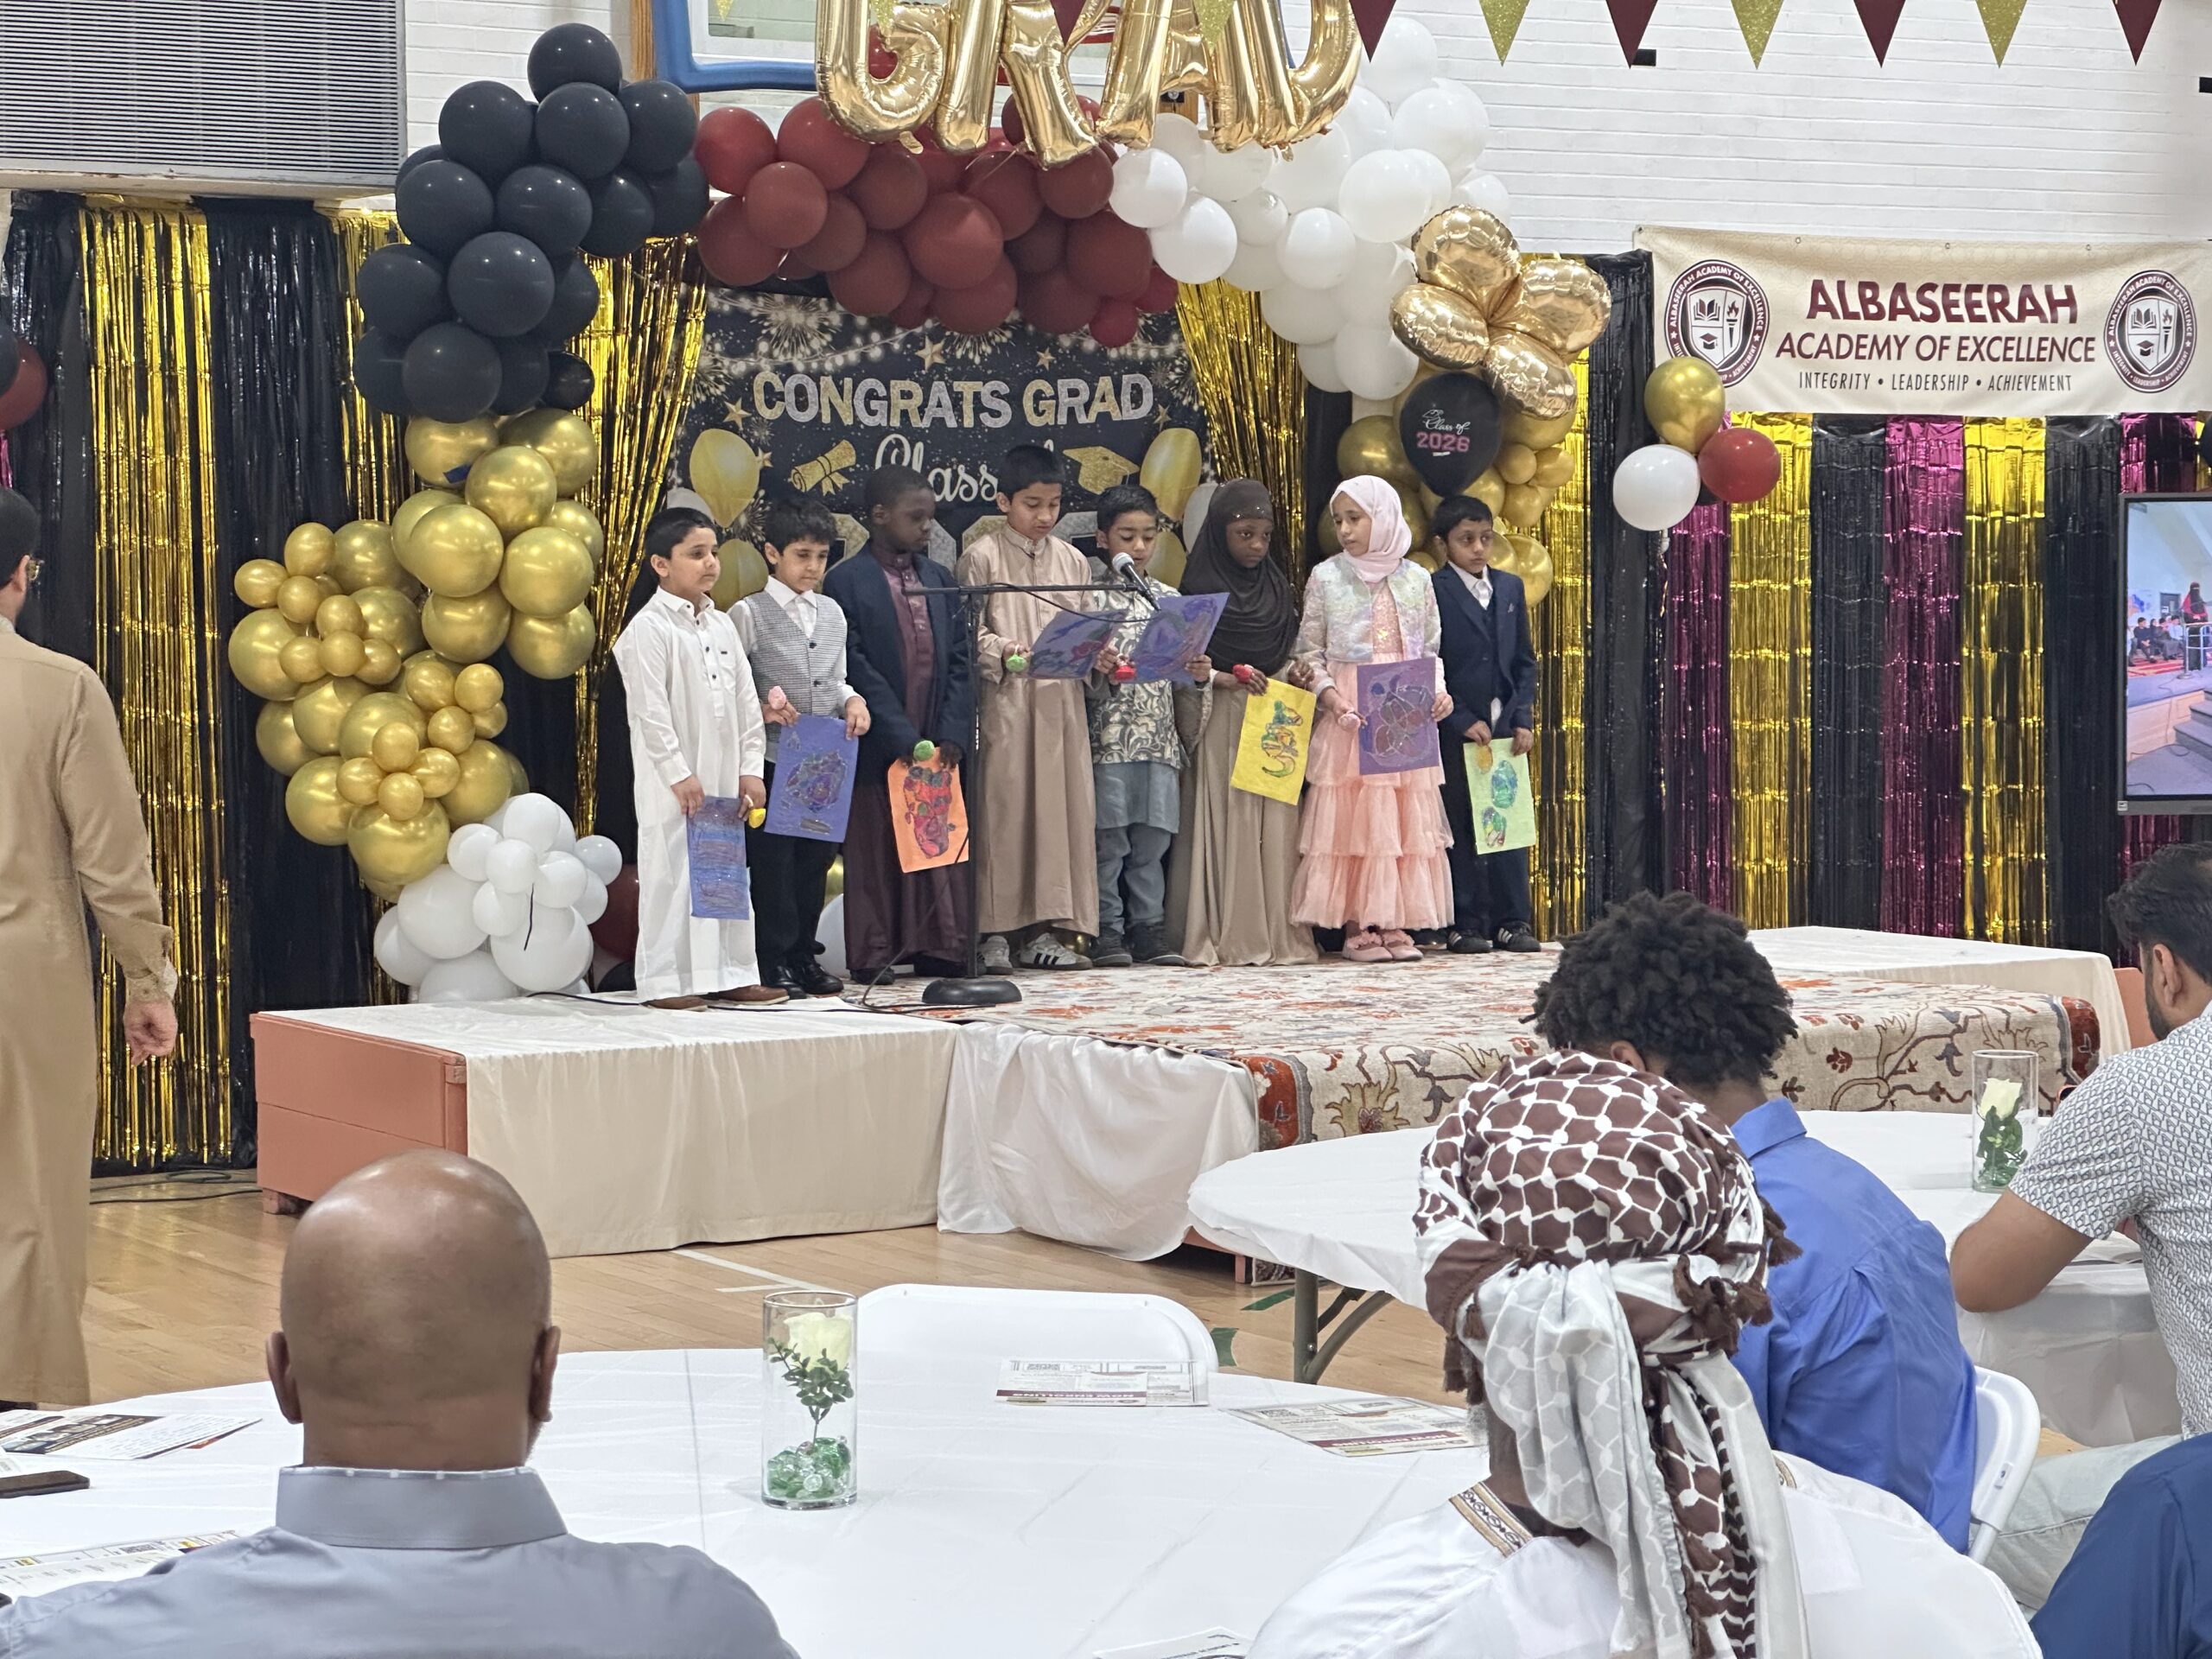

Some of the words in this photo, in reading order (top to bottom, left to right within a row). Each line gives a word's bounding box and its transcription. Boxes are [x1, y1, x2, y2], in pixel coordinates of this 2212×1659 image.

[817, 0, 1363, 171] GRAD
[1669, 275, 1695, 327] ALBASEERAH
[1695, 265, 1732, 278] ACADEMY
[1732, 272, 1745, 283] OF
[1744, 280, 1764, 331] EXCELLENCE
[1807, 279, 2078, 324] ALBASEERAH
[2108, 285, 2136, 336] ALBASEERAH
[2135, 276, 2166, 289] ACADEMY
[2164, 281, 2175, 291] OF
[2173, 289, 2193, 337] EXCELLENCE
[1777, 332, 1910, 361] ACADEMY
[1916, 334, 1951, 362] OF
[1956, 335, 2095, 363] EXCELLENCE
[753, 371, 1012, 429] CONGRATS
[1022, 373, 1154, 427] GRAD
[1799, 371, 1871, 390] INTEGRITY
[1891, 373, 1969, 391] LEADERSHIP
[1987, 374, 2072, 392] ACHIEVEMENT
[1416, 431, 1471, 453] 2026
[1422, 418, 1452, 431] Class
[1455, 421, 1471, 435] of
